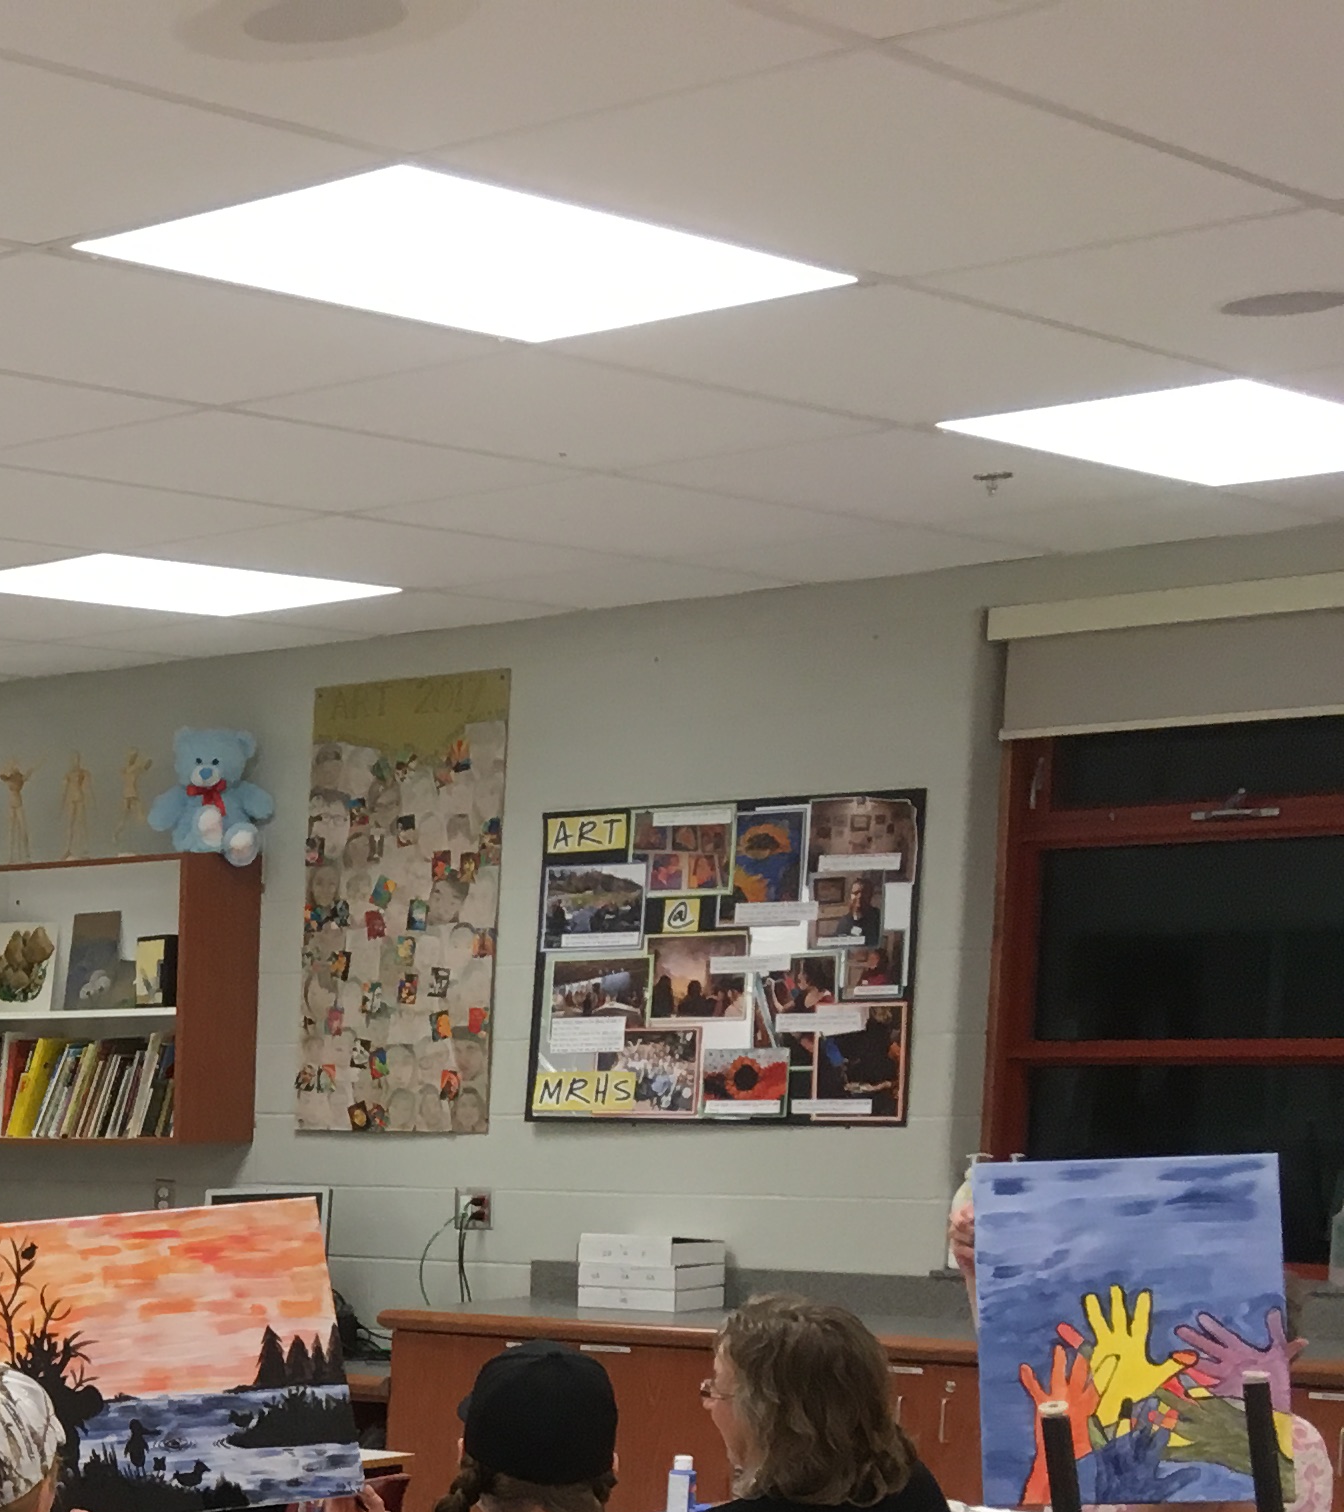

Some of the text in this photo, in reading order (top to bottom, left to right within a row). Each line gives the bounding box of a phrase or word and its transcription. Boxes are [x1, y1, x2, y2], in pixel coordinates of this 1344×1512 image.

[553, 818, 622, 849] ART
[667, 901, 695, 929] @
[538, 1073, 632, 1105] MRHS
